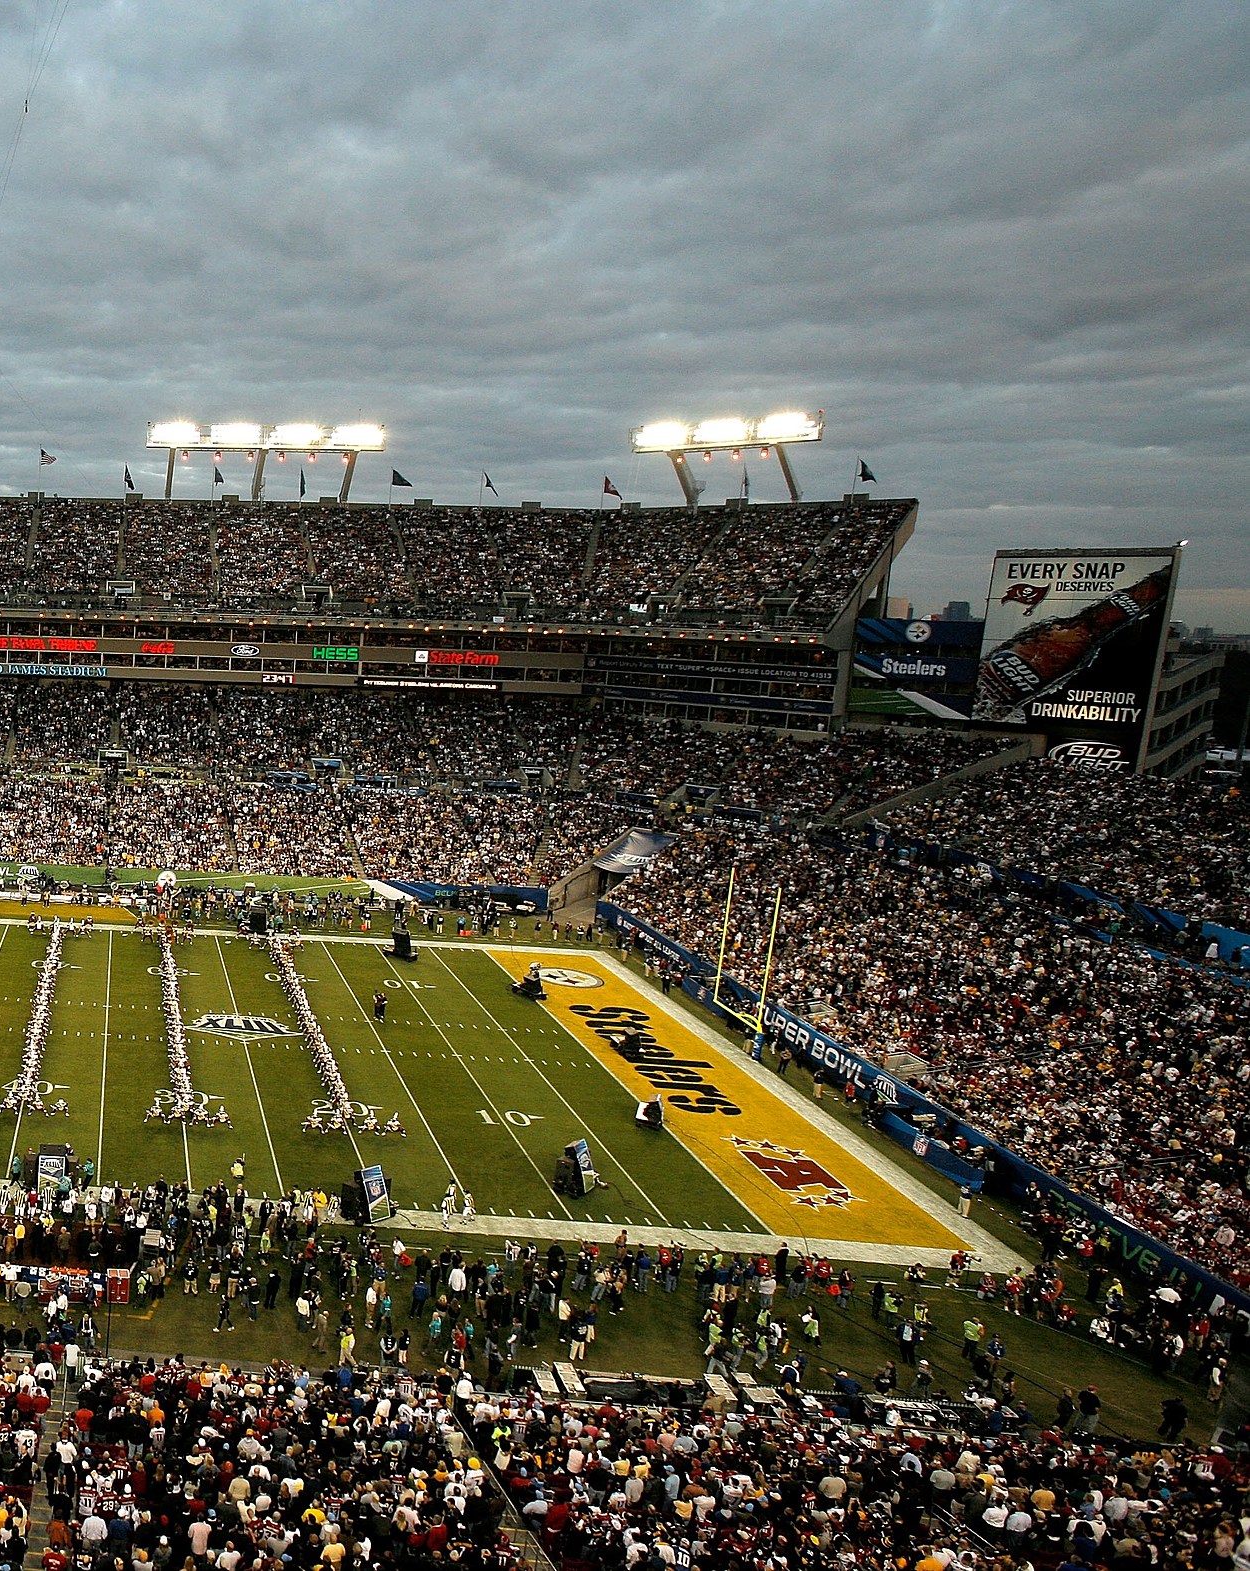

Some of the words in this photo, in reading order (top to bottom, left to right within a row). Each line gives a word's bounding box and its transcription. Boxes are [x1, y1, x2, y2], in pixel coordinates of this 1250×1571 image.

[1007, 563, 1068, 580] EVERY
[1071, 563, 1125, 580] SNAP
[1055, 580, 1114, 593] DESERVES
[312, 647, 359, 660] HESS
[428, 651, 463, 664] State
[465, 652, 499, 665] Farm
[5, 664, 47, 675] JAMES
[49, 665, 108, 677] STADIUM
[761, 669, 797, 677] LOCATION
[881, 658, 946, 676] Steelers
[1007, 653, 1041, 684] BUD
[993, 656, 1036, 694] LIGHT
[1066, 689, 1136, 705] SUPERIOR
[1031, 703, 1142, 723] DRINKABILITY
[1066, 744, 1122, 759] BUD
[200, 1017, 291, 1034] XLIII
[811, 1038, 867, 1090] BOWL
[475, 1109, 531, 1127] 10
[402, 1383, 409, 1393] 11
[788, 1458, 799, 1468] 43
[116, 1470, 124, 1479] 11
[82, 1497, 93, 1508] 11
[102, 1500, 114, 1511] 29
[458, 1546, 466, 1558] 7
[498, 1556, 506, 1566] 11
[676, 1551, 691, 1568] 10
